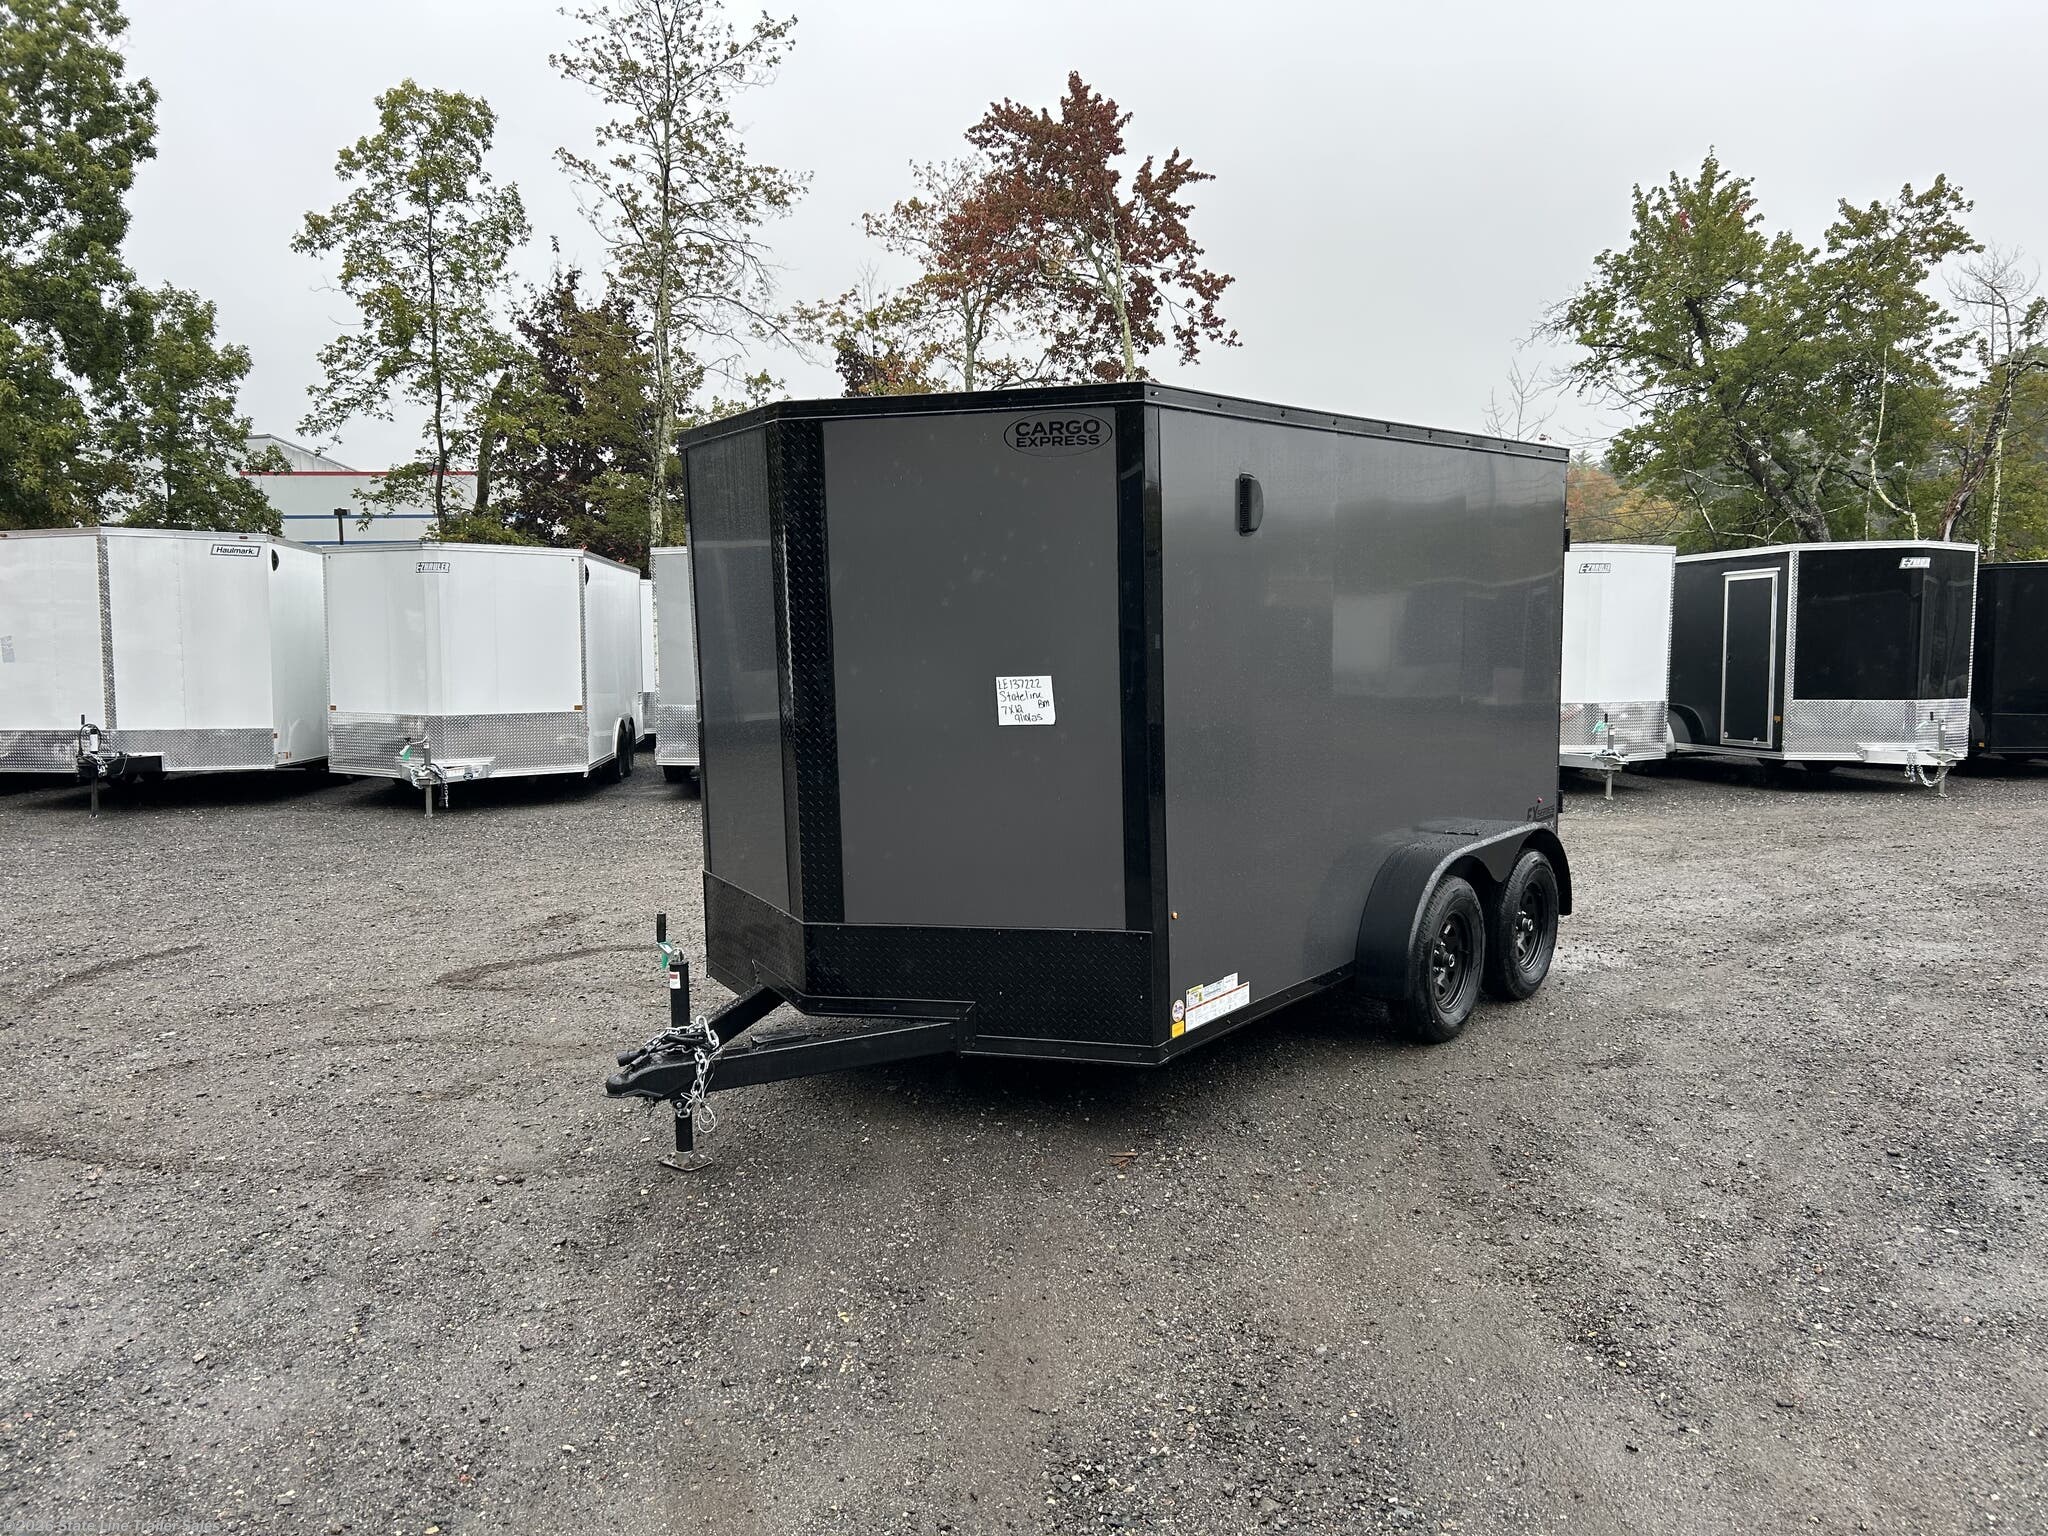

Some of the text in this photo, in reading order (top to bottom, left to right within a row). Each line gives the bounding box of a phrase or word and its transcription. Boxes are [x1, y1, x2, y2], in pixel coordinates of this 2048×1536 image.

[1015, 419, 1101, 437] CARGO
[1016, 434, 1101, 448] EXPRESS
[216, 546, 254, 555] Haulmark
